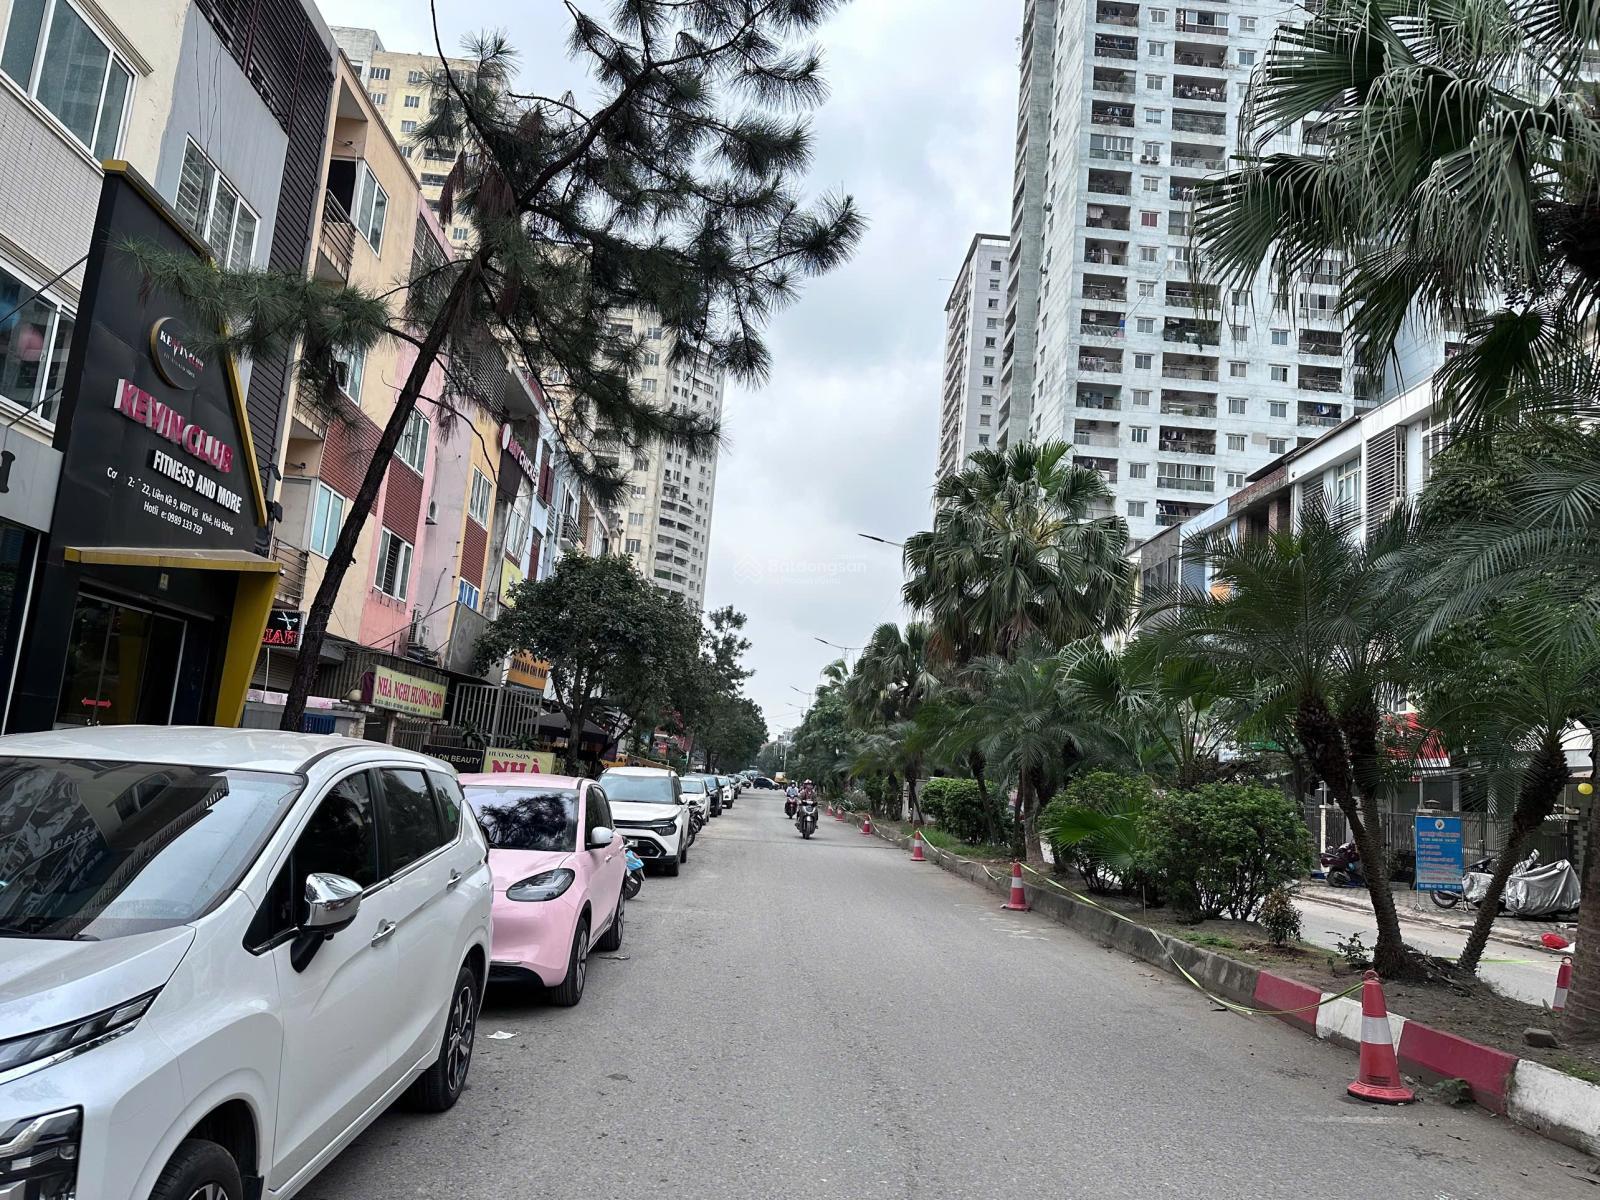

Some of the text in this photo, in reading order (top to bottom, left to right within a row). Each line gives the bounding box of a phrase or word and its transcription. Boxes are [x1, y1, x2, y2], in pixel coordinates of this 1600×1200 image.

[114, 379, 234, 473] KEVIN CLUB
[153, 449, 242, 514] FITNESS AND MORE
[142, 483, 151, 497] 22,
[167, 512, 181, 525] 0989
[182, 518, 192, 530] 133
[451, 755, 481, 765] BEAUTY
[488, 750, 514, 759] HƯƠNG
